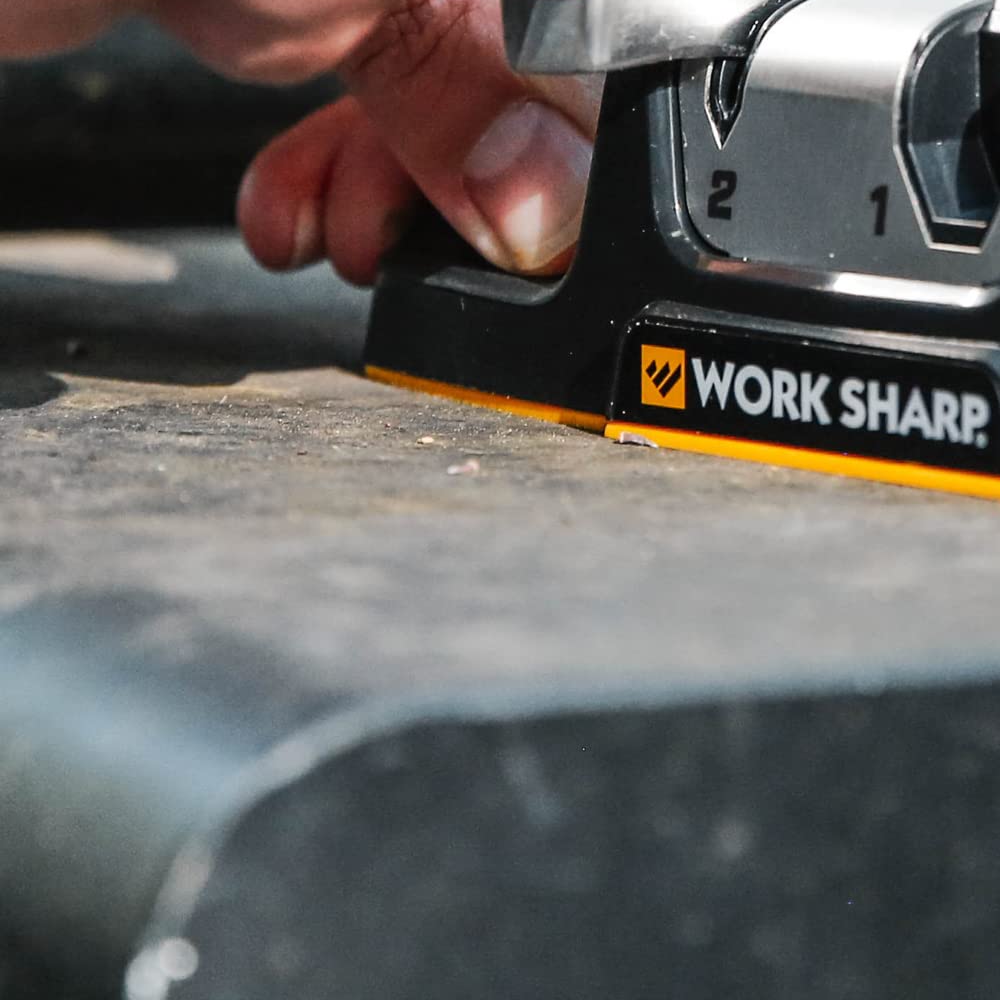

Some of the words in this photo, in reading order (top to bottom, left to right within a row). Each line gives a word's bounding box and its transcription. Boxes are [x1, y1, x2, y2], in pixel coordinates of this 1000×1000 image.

[708, 170, 737, 220] 2
[870, 185, 889, 236] 1
[691, 358, 831, 425] WORK
